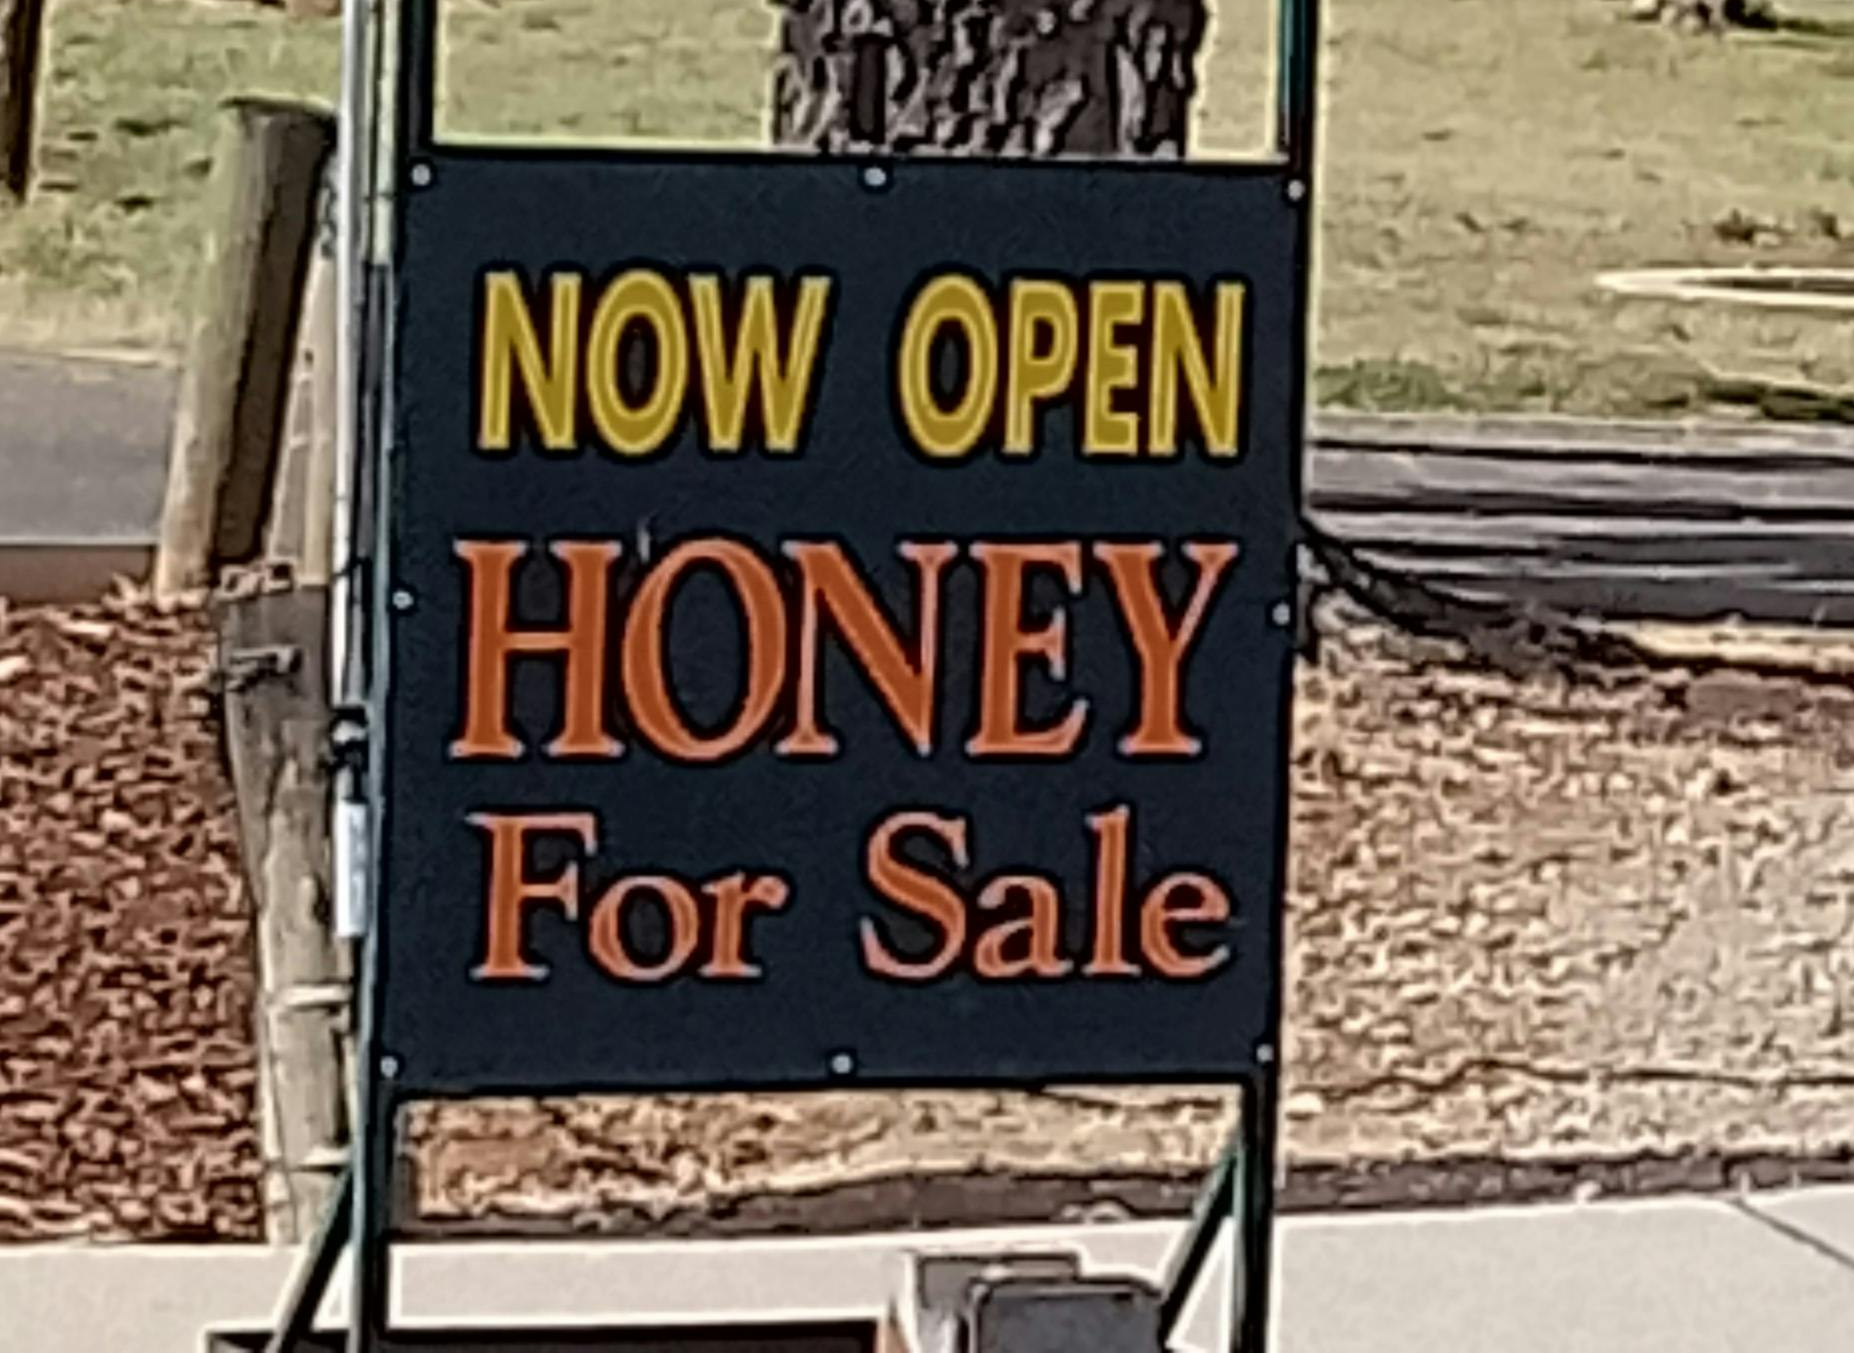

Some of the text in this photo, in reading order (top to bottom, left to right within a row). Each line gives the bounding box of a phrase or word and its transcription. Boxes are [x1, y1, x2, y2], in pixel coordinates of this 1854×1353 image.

[479, 270, 1245, 456] NOW OPEN
[450, 538, 1238, 759] HONEY
[466, 805, 1233, 980] For Sale
